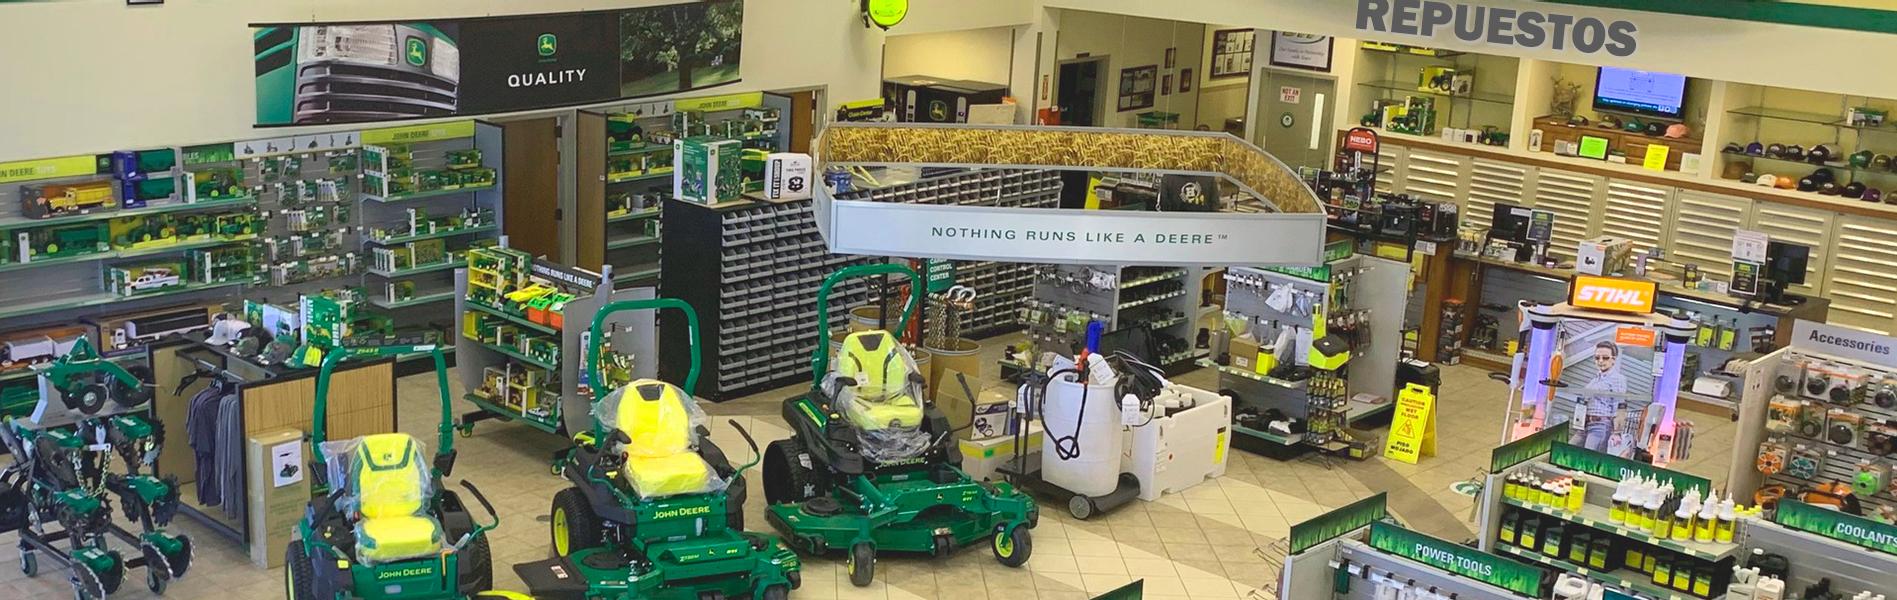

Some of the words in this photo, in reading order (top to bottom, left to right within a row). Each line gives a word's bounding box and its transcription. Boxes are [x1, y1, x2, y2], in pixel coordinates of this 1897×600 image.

[1355, 0, 1637, 57] REPUESTOS
[507, 68, 586, 88] QUALITY
[1350, 135, 1371, 144] NEBO
[931, 226, 1017, 241] NOTHING
[1025, 230, 1076, 242] RUNS
[1086, 232, 1125, 243] LIKE
[1133, 232, 1145, 243] A
[930, 263, 953, 273] CONTROL
[930, 272, 950, 281] CENTER
[1578, 285, 1646, 306] STIHL
[1809, 330, 1891, 355] Accessories
[1402, 397, 1426, 406] CAUTION
[1401, 412, 1419, 420] FLOOR
[1390, 445, 1414, 455] MOJADO
[1396, 440, 1410, 448] PISO
[653, 509, 678, 520] JOHN
[679, 506, 711, 516] DEERE
[1836, 522, 1897, 546] COOLANTS
[1415, 543, 1455, 565] POWER
[1455, 556, 1492, 577] TOOLS
[378, 570, 402, 579] JOHN
[403, 567, 432, 577] DEERE
